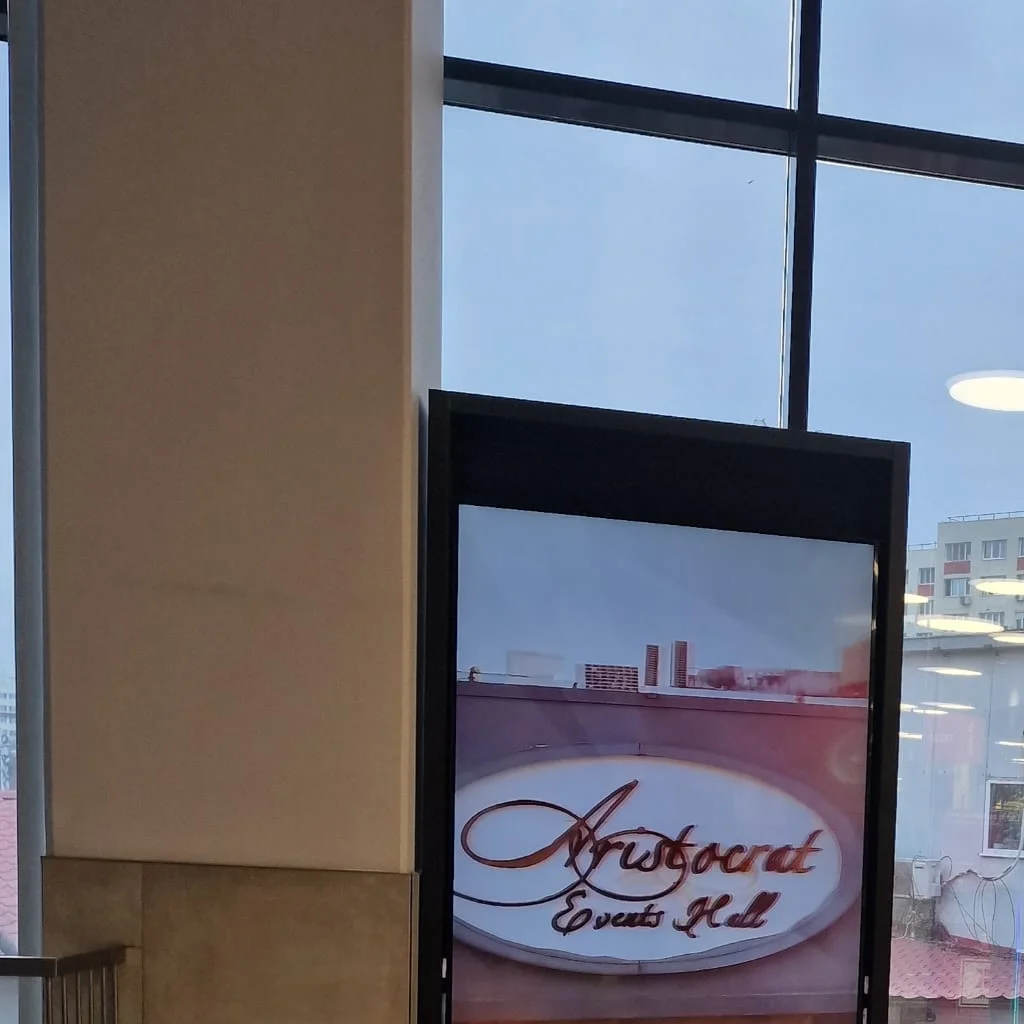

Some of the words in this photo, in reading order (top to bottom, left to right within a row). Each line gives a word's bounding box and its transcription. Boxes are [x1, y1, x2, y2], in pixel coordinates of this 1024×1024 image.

[458, 778, 824, 904] Aristocrat
[551, 889, 665, 936] Events
[673, 891, 782, 938] Hall
